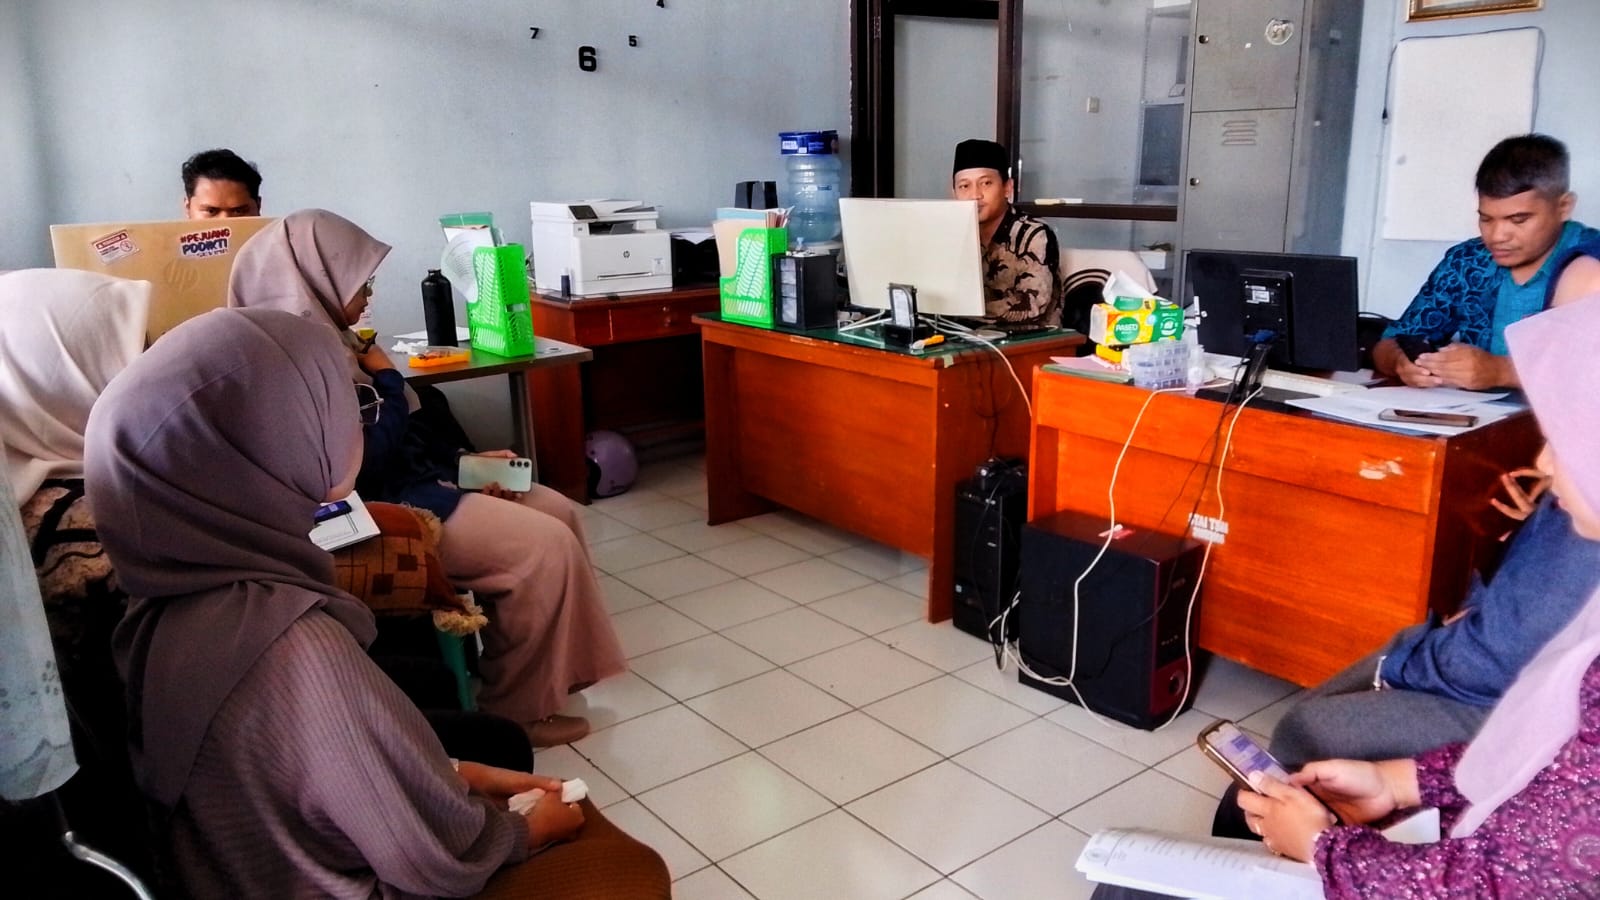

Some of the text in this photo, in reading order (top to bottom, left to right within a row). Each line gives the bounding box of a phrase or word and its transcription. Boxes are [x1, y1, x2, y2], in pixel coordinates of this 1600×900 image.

[656, 0, 665, 8] 4
[530, 27, 540, 39] 7
[628, 35, 637, 47] 5
[578, 46, 597, 72] 6
[180, 228, 231, 244] #PEJUANG
